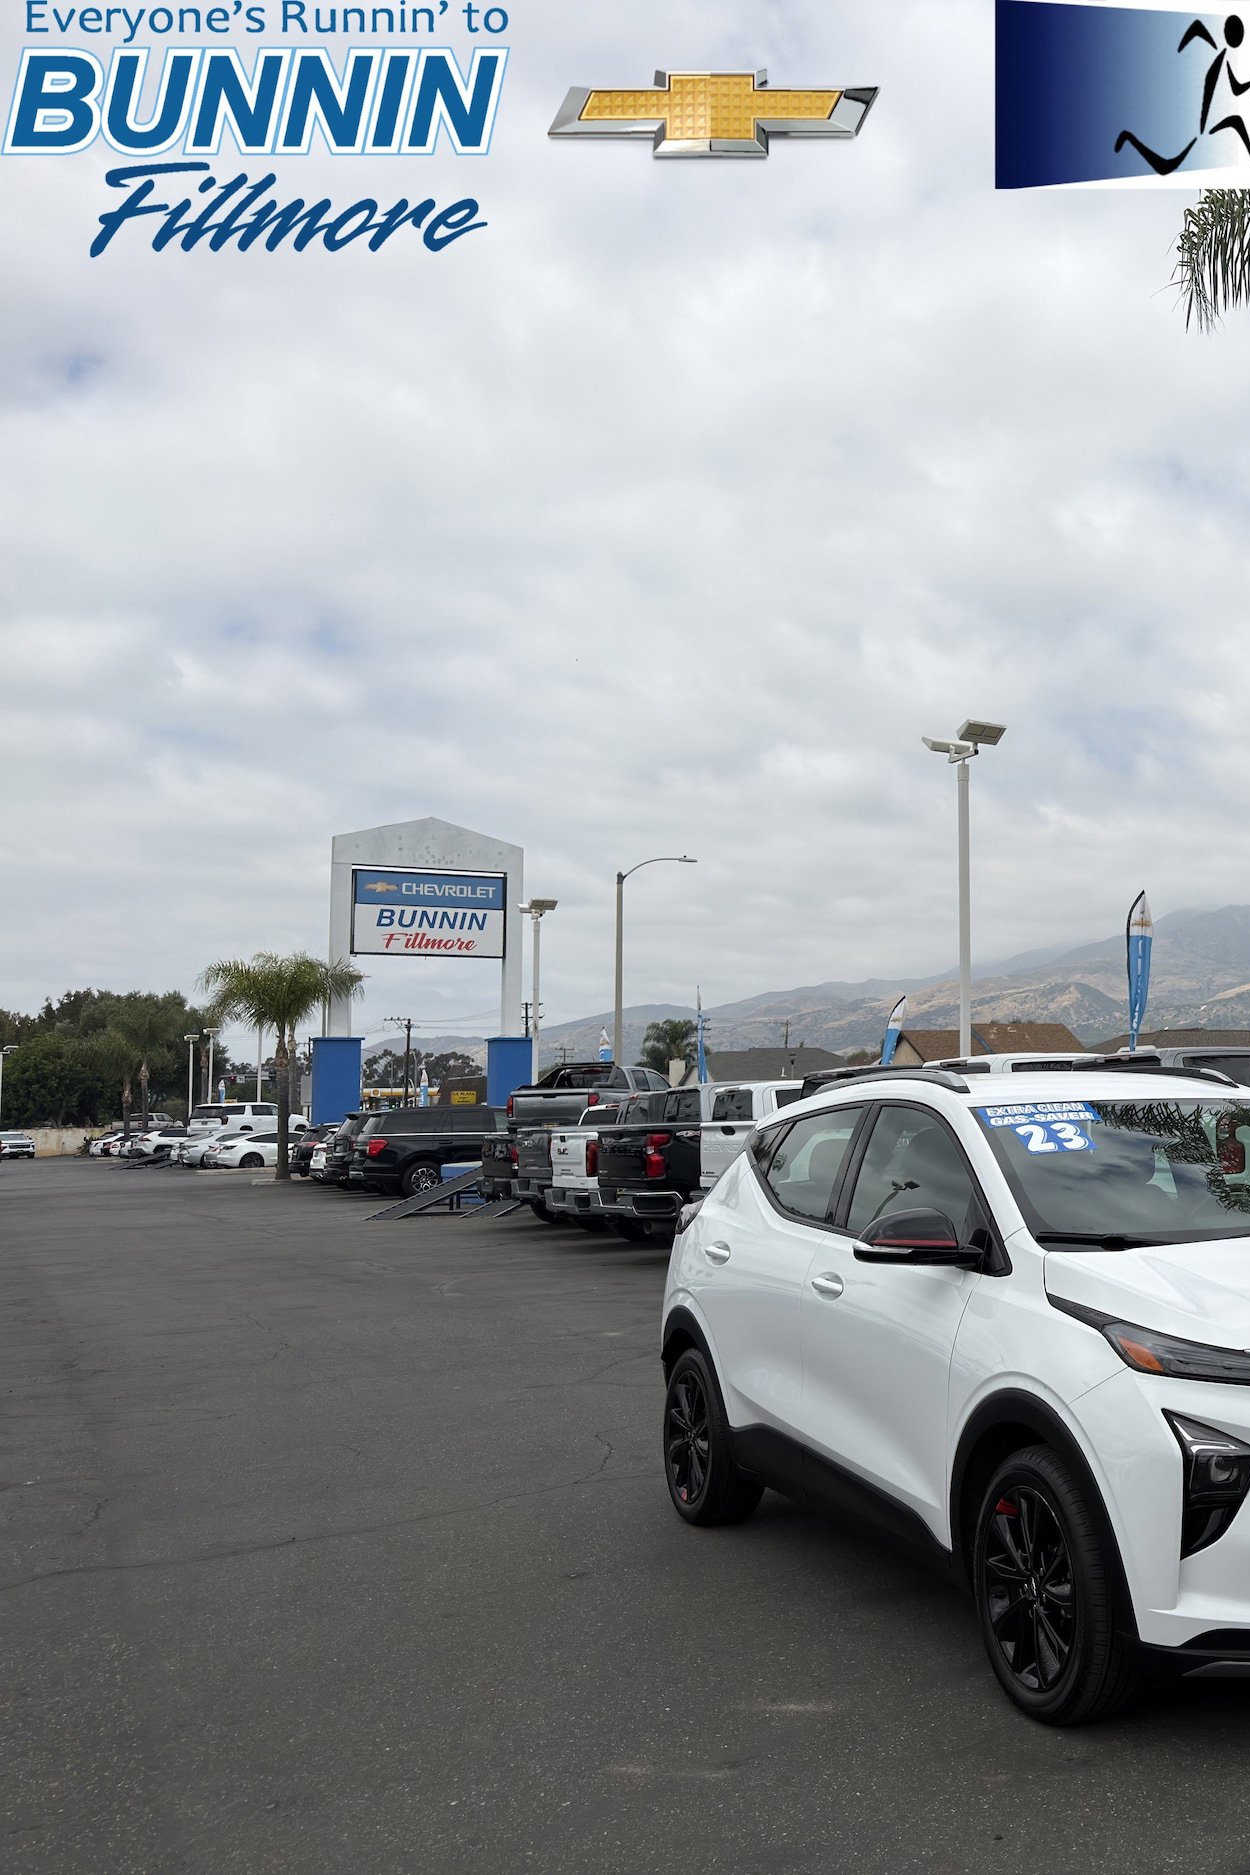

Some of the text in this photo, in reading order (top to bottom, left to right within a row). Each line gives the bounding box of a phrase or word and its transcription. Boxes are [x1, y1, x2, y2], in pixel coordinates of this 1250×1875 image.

[401, 882, 496, 899] CHEVROLET
[376, 908, 488, 931] BUNNIN
[381, 932, 478, 951] Fillmore
[985, 1102, 1086, 1117] EXTRA CLEAN
[1015, 1122, 1090, 1153] 23
